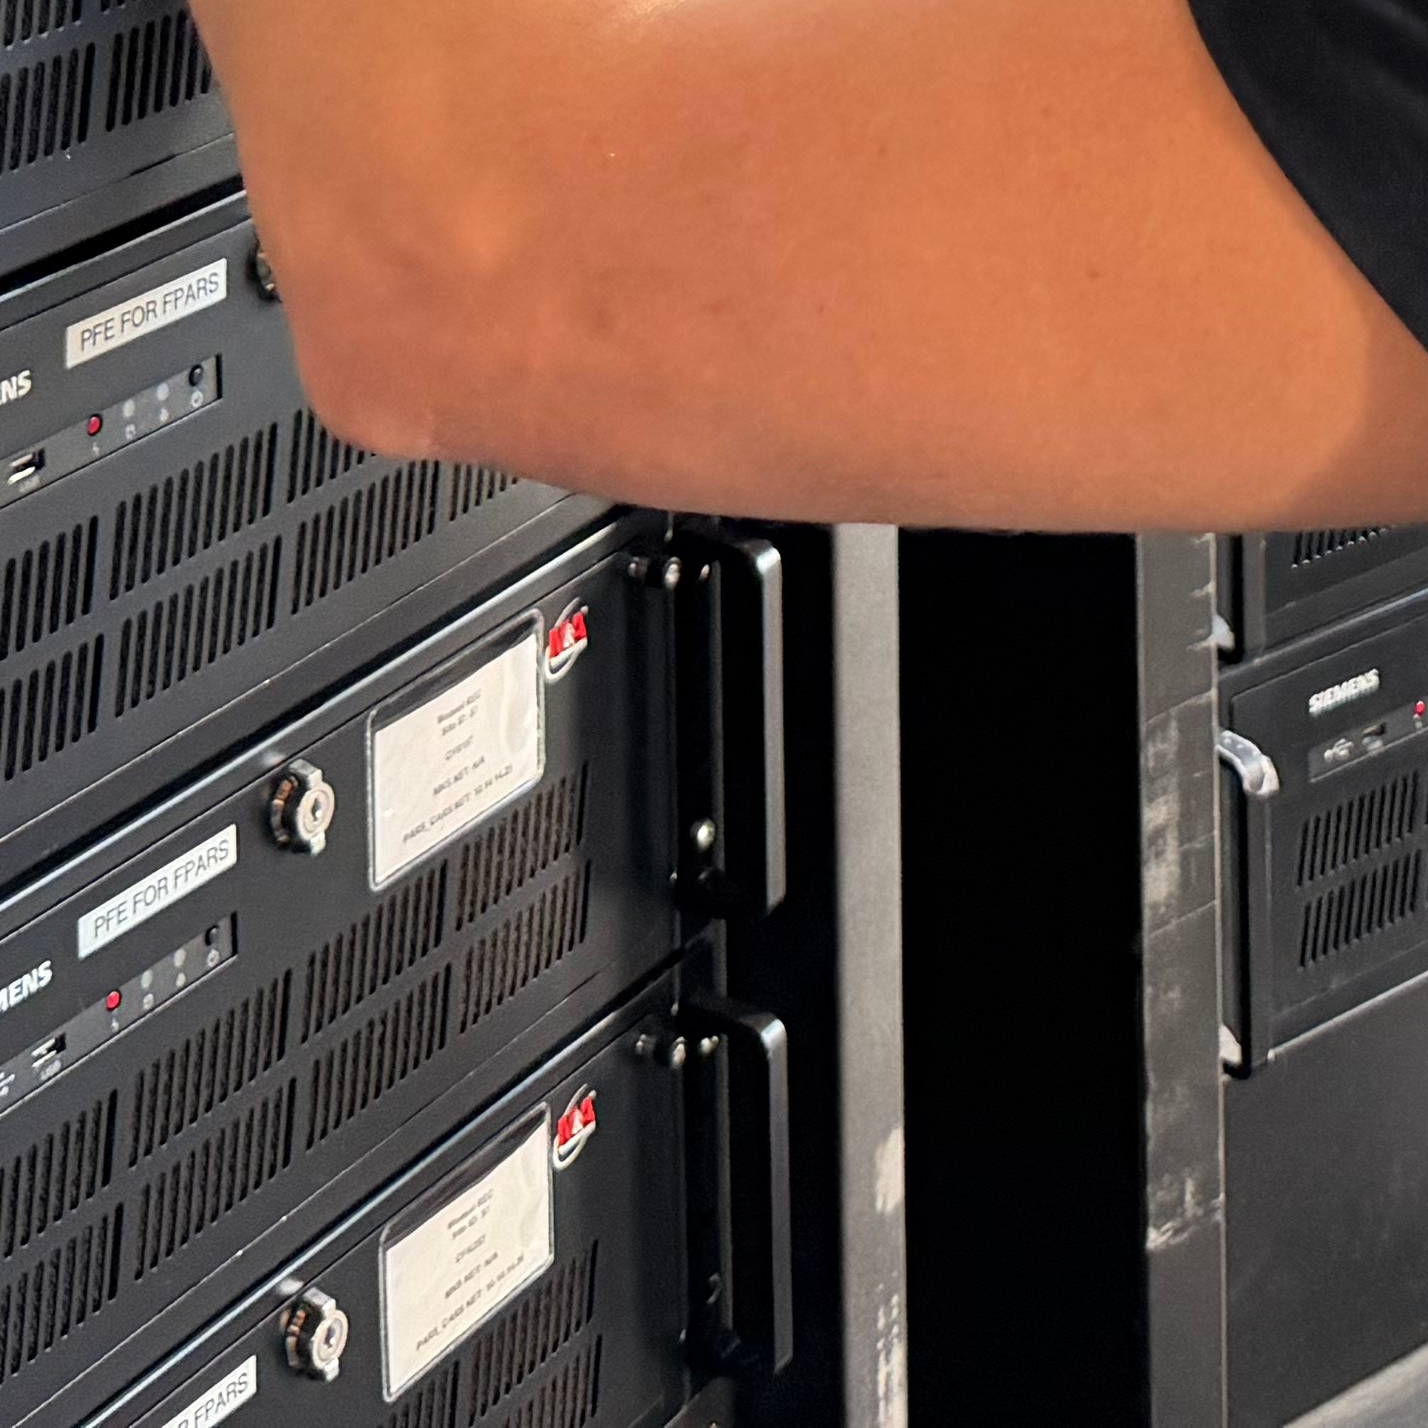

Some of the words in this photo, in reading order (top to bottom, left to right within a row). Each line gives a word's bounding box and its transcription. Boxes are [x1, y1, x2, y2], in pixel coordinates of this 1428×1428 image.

[80, 317, 116, 352] PFE
[120, 300, 159, 334] FOR
[162, 272, 220, 315] FPARS
[1308, 668, 1381, 718] SIEMENS
[93, 900, 128, 940] PFE
[131, 875, 169, 916] FOR
[173, 839, 230, 891] FPARS
[194, 1372, 249, 1426] FPARS
